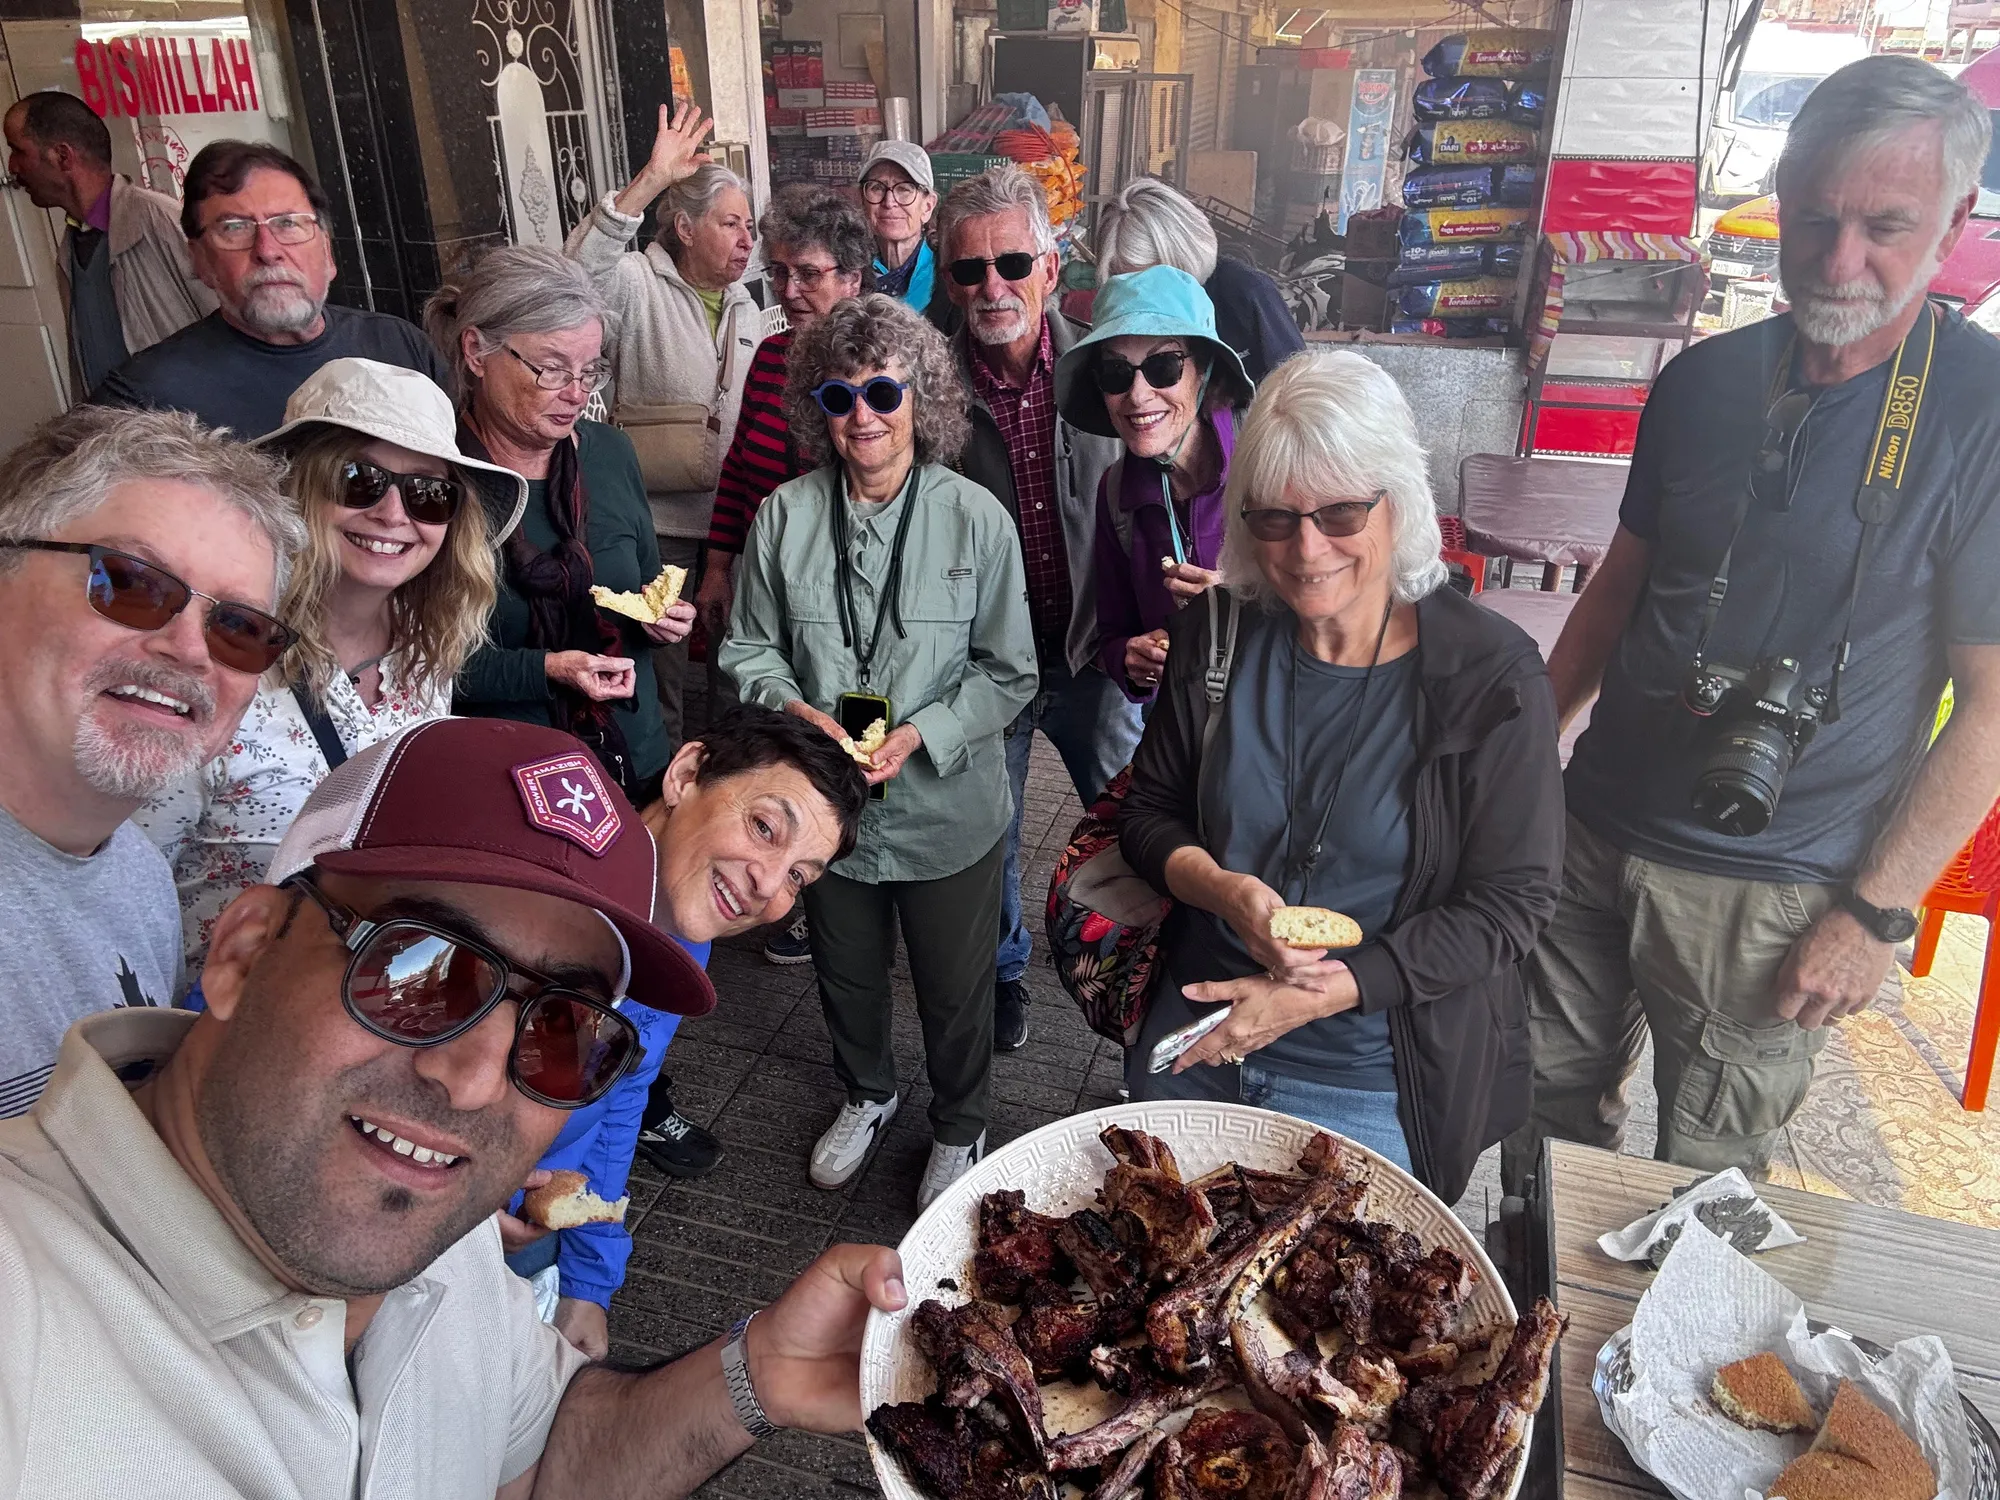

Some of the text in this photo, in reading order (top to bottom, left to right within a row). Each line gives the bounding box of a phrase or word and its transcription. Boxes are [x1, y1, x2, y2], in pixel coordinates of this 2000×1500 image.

[75, 37, 260, 119] BISMILLAH
[1440, 144, 1459, 152] DARI
[1878, 375, 1920, 479] Nikon D850
[1756, 699, 1787, 715] Nikon
[526, 778, 547, 814] POWER
